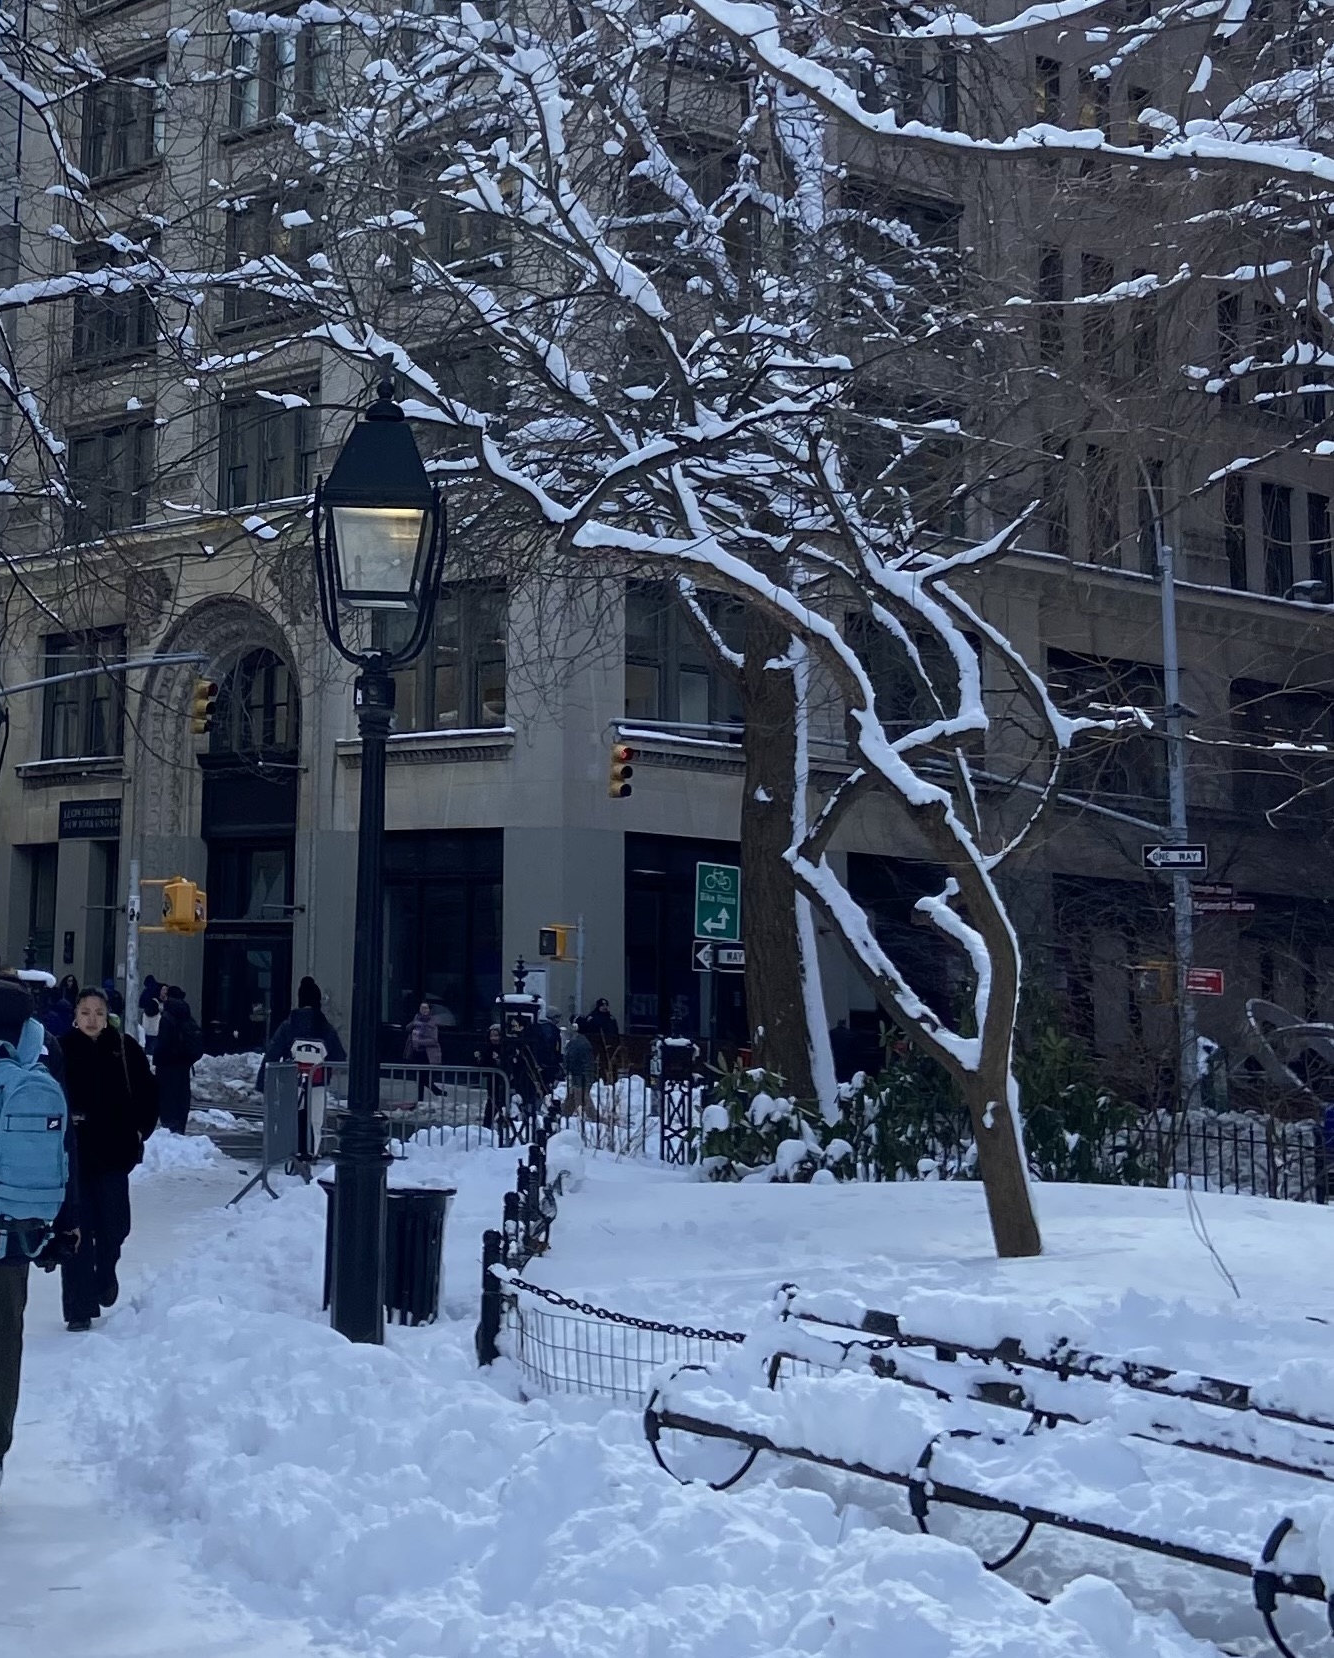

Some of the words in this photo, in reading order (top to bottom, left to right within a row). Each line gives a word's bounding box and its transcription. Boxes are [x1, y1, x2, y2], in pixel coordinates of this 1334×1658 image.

[1152, 852, 1170, 862] ONE
[1178, 852, 1198, 862] WAY
[726, 951, 743, 961] WAY
